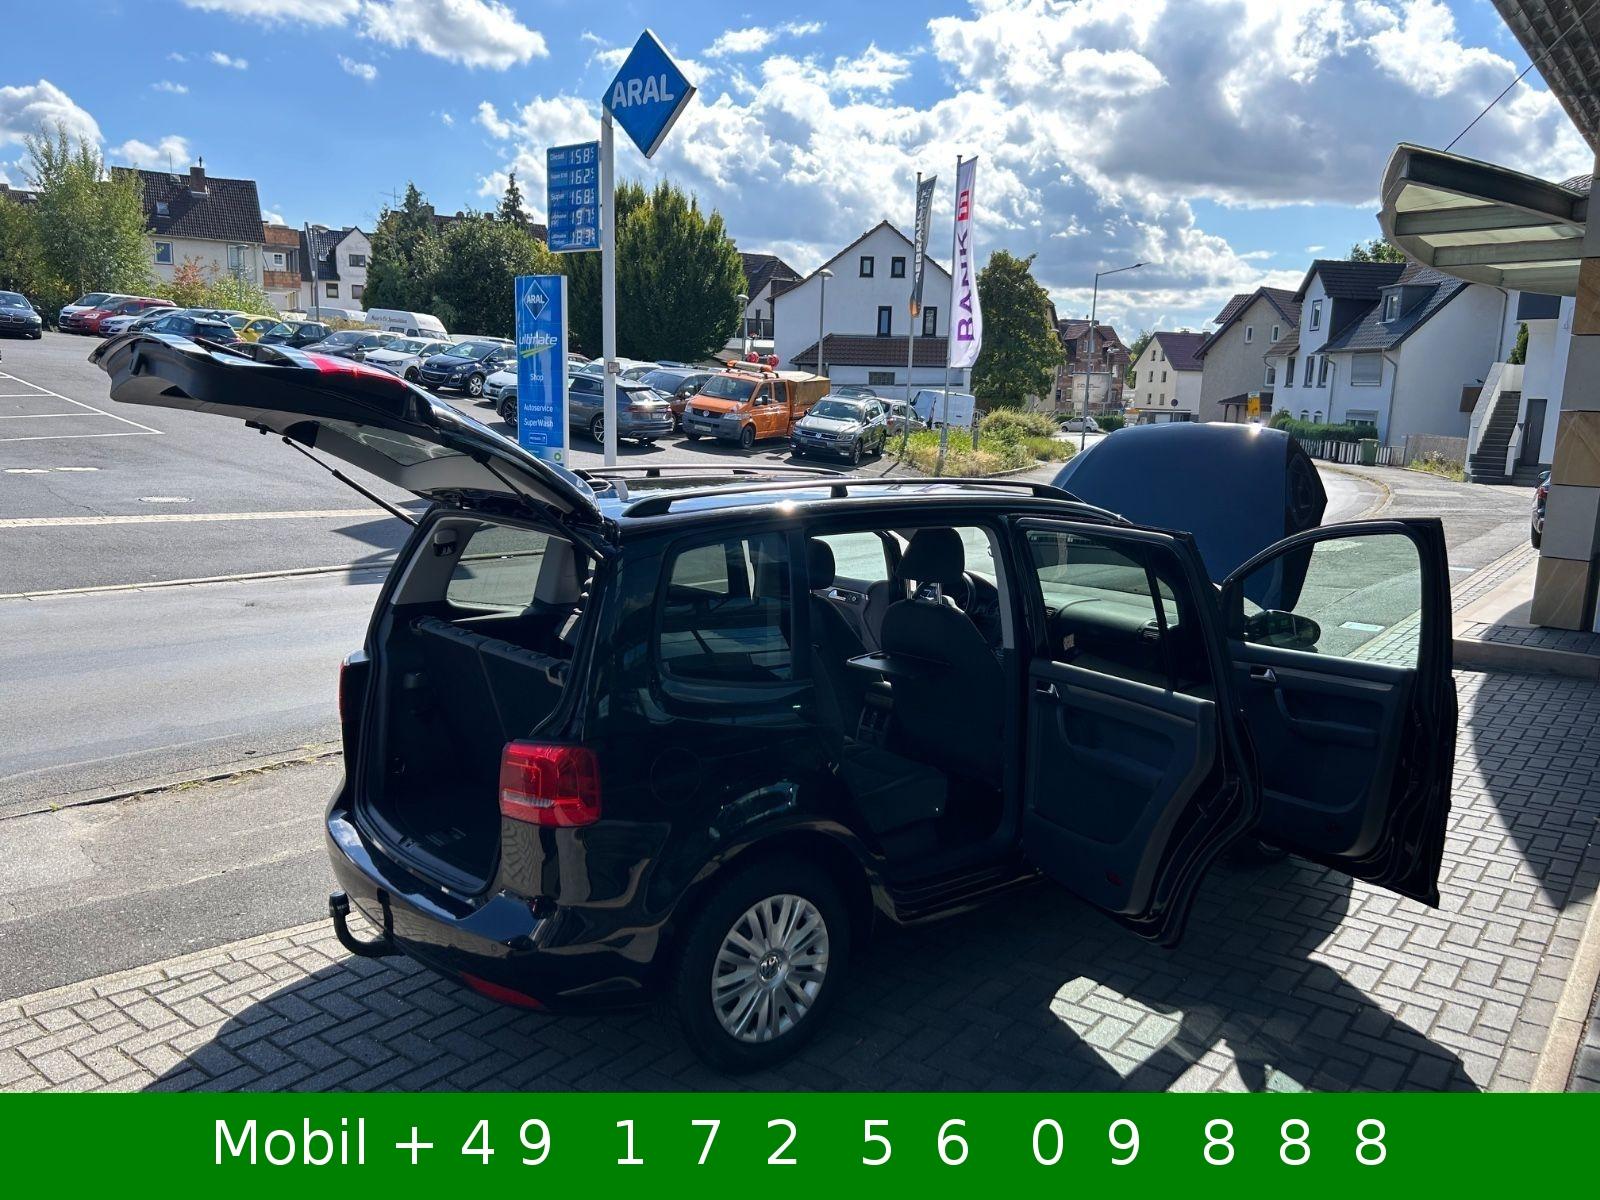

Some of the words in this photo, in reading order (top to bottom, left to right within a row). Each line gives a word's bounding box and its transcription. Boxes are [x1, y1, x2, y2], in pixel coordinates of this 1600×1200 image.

[611, 73, 674, 109] ARAL
[957, 229, 975, 342] BANK
[526, 294, 545, 304] ARAL
[530, 373, 544, 383] Shop
[523, 403, 553, 413] Autoservice
